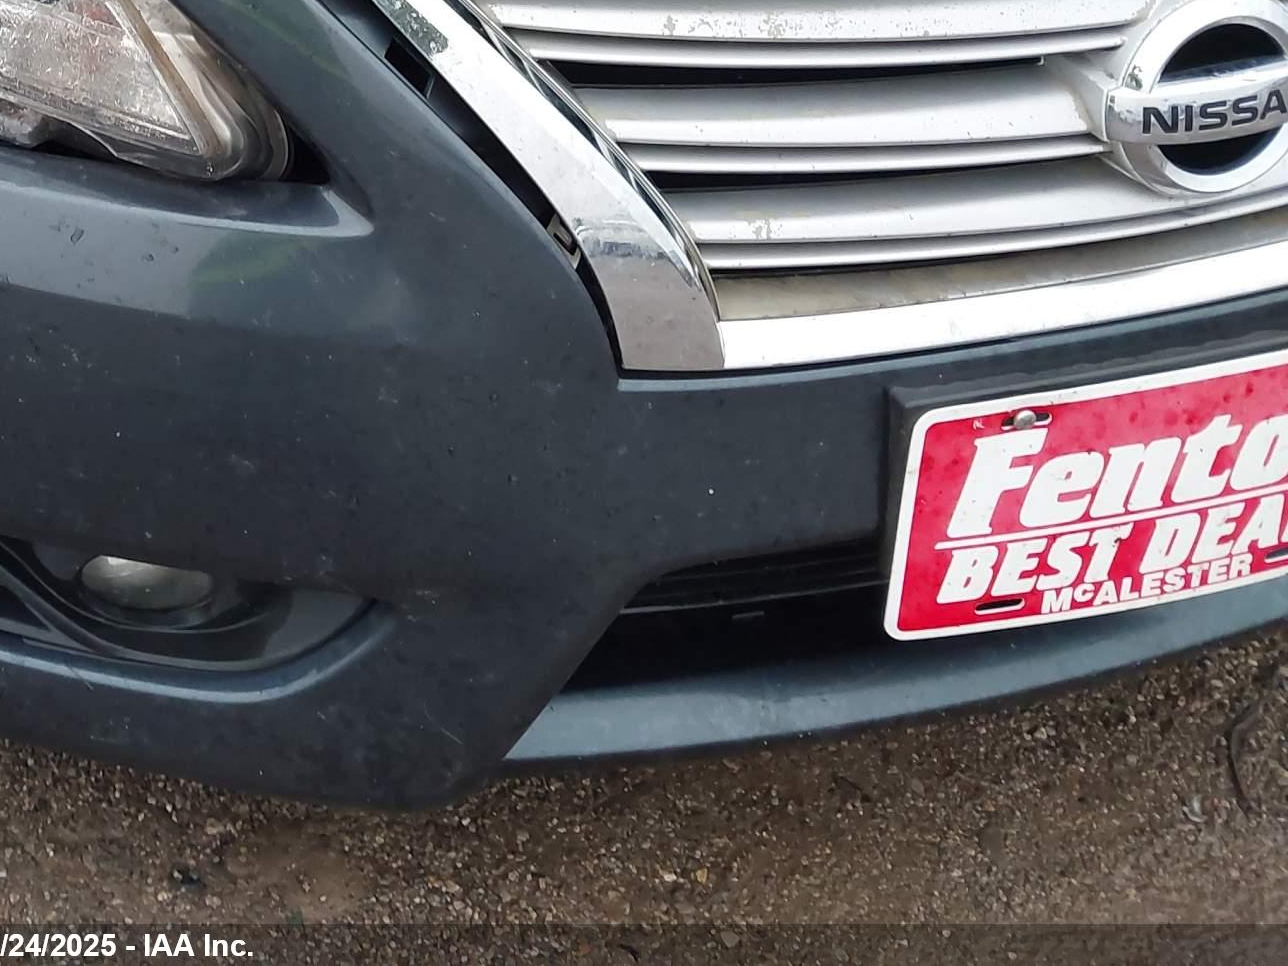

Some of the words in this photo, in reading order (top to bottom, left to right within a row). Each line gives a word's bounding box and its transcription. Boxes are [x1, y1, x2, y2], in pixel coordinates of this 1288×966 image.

[1142, 89, 1288, 134] NISSA
[946, 414, 1288, 539] Fento
[936, 522, 1134, 605] BEST
[1139, 494, 1288, 575] DEA
